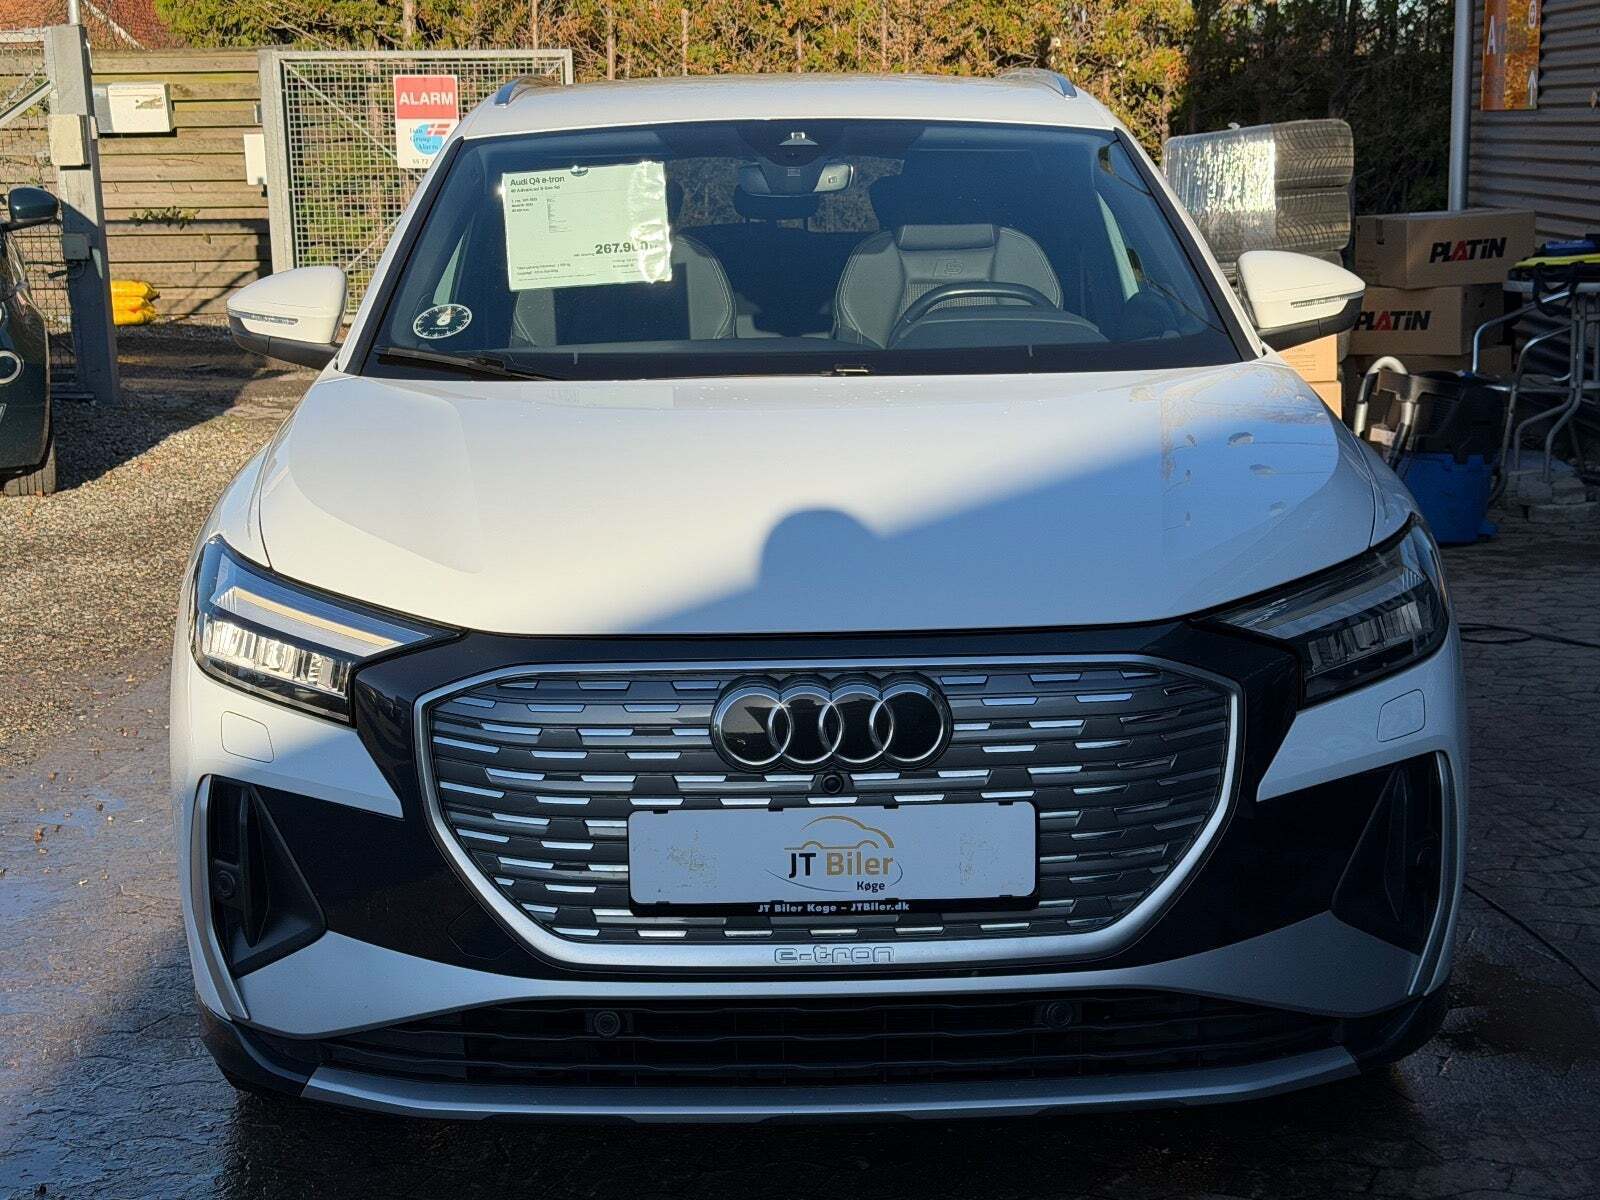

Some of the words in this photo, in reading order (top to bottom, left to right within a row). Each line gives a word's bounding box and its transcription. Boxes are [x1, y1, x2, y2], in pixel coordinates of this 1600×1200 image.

[399, 91, 453, 105] ALARM
[510, 178, 528, 187] Audi
[529, 177, 540, 185] Q4
[541, 175, 565, 184] e-tron
[788, 852, 817, 879] JT
[826, 851, 894, 876] Biler
[856, 881, 886, 893] Køge
[758, 904, 771, 913] JT
[774, 903, 804, 913] Biler
[850, 901, 910, 912] JTBiler.dk
[774, 945, 895, 964] e-tron
